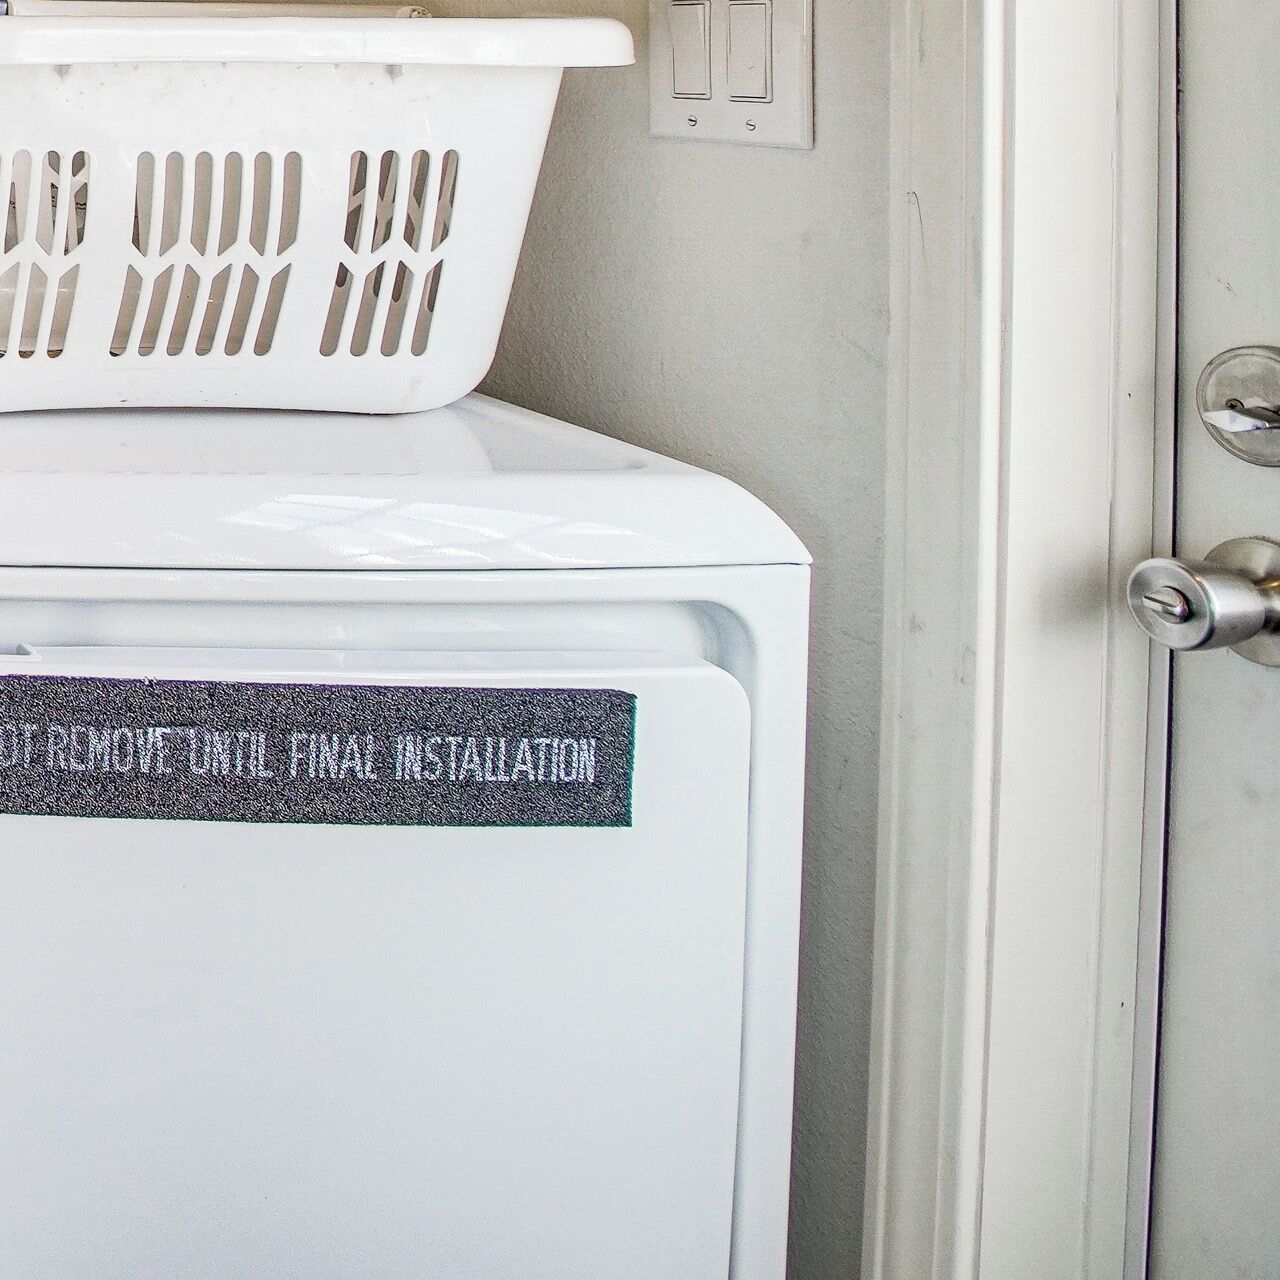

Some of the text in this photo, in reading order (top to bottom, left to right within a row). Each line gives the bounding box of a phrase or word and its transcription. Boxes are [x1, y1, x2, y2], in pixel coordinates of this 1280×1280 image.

[45, 724, 173, 774] REMOVE
[188, 727, 274, 777] UNTIL
[290, 733, 380, 781] FINAL
[392, 734, 598, 783] INSTALLATION
